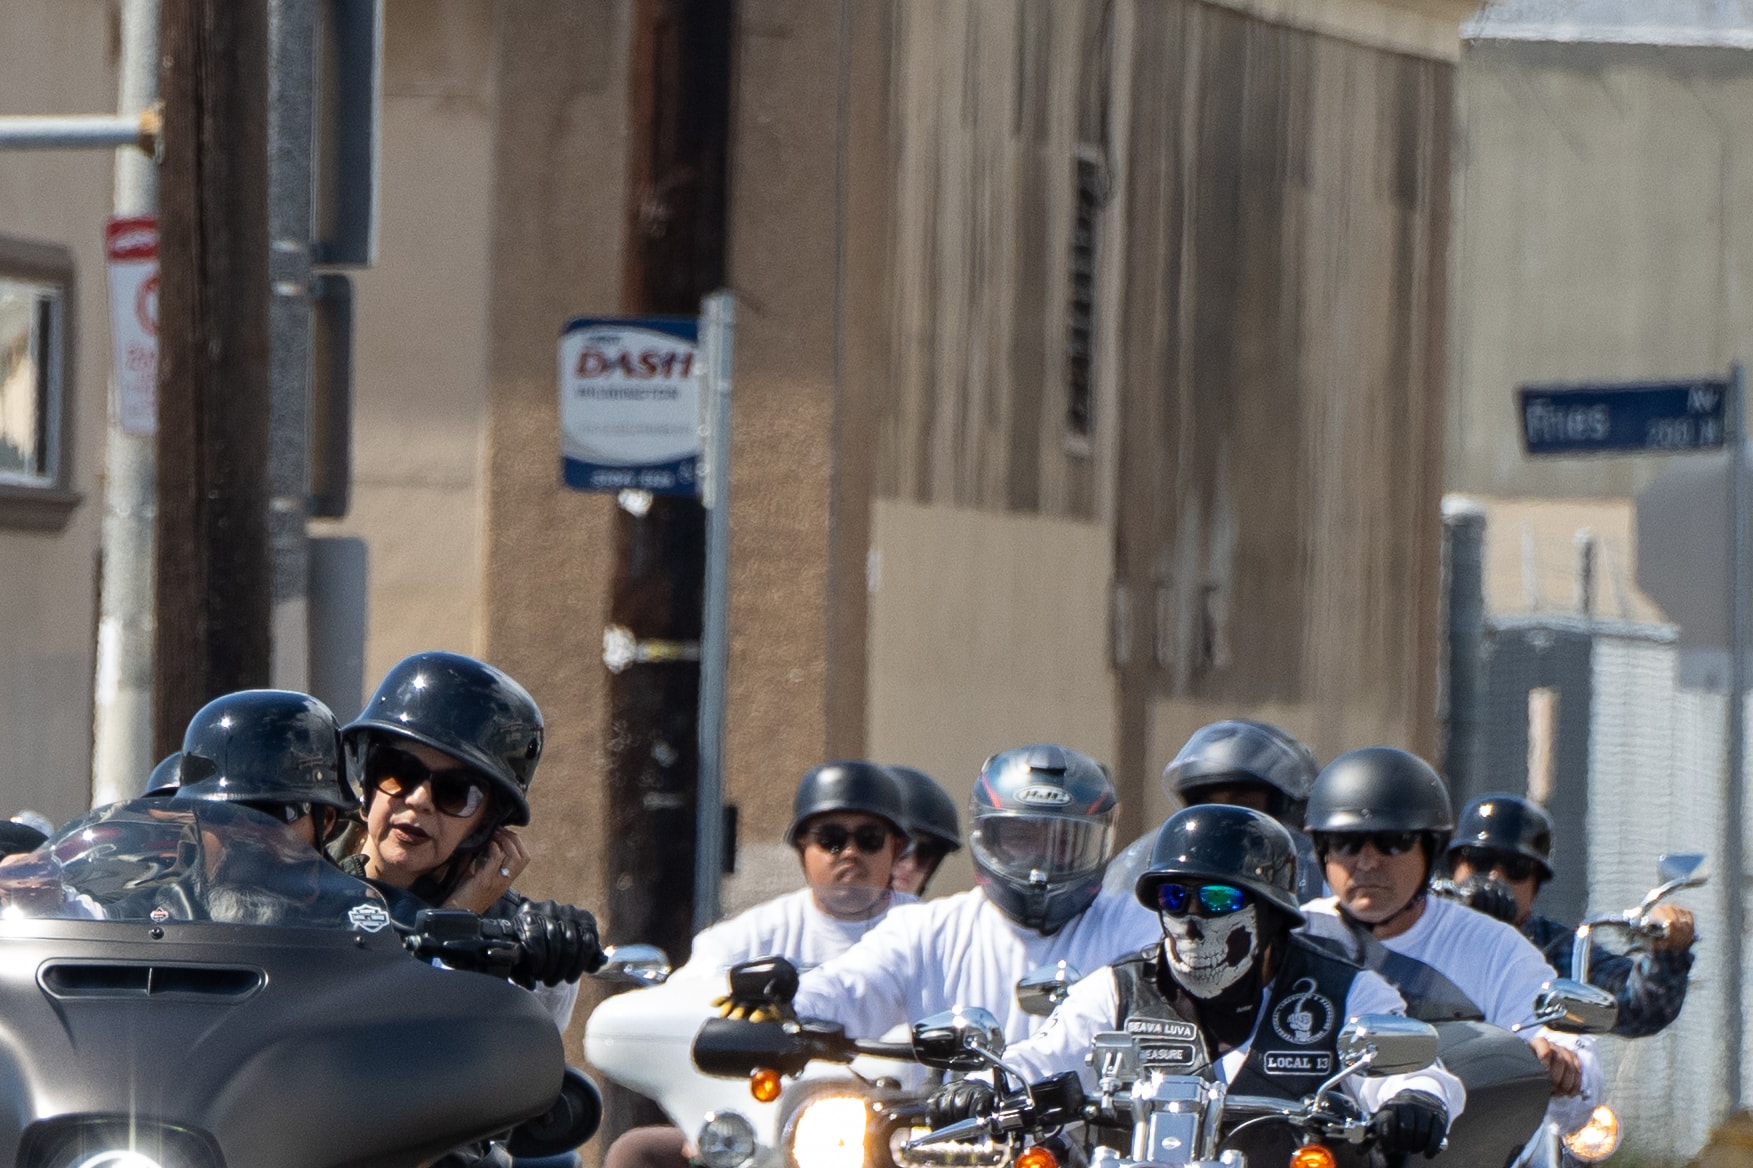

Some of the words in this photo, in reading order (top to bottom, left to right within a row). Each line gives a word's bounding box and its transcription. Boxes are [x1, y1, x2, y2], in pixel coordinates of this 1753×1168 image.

[576, 348, 694, 380] DASH
[1164, 1024, 1192, 1036] LUVA
[1268, 1057, 1312, 1069] LOCAL
[1316, 1058, 1329, 1069] 13
